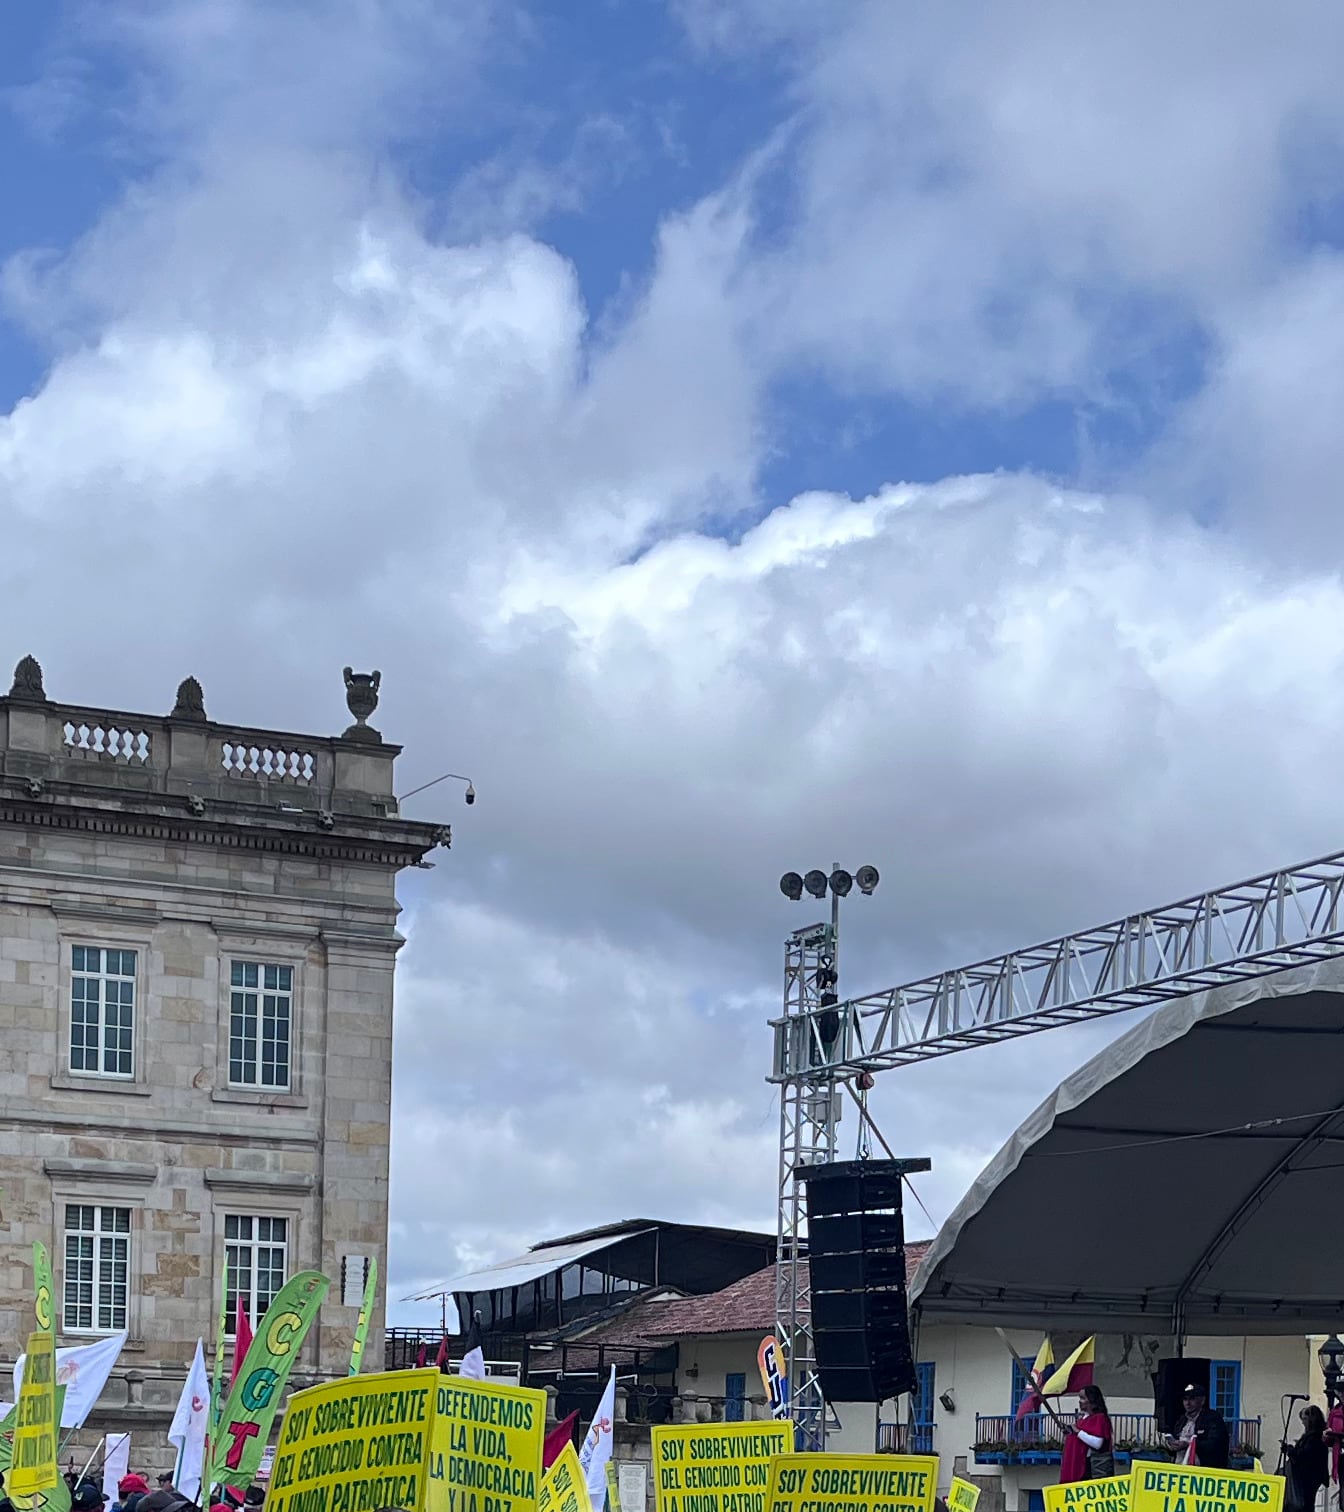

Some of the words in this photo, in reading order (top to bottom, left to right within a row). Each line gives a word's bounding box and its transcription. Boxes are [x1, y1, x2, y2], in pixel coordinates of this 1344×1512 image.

[225, 1311, 303, 1470] CGT
[285, 1407, 312, 1445] SOY
[313, 1389, 428, 1436] SOBREVIVIENTE
[437, 1388, 533, 1431] DEFENDEMOS
[275, 1453, 296, 1490] DEL
[298, 1438, 364, 1482] GENOCIDIO
[367, 1432, 422, 1469] CONTRA
[450, 1423, 467, 1452] LA
[473, 1427, 512, 1464] VIDA,
[661, 1439, 684, 1461] SOY
[690, 1434, 784, 1460] SOBREVIVIENTE
[430, 1452, 444, 1480] LA
[553, 1463, 573, 1499] SOY
[661, 1468, 681, 1489] DEL
[685, 1465, 740, 1488] GENOCIDIO
[778, 1469, 807, 1494] SOY
[811, 1469, 928, 1498] SOBREVIVIENTE
[1144, 1471, 1269, 1503] DEFENDEMOS
